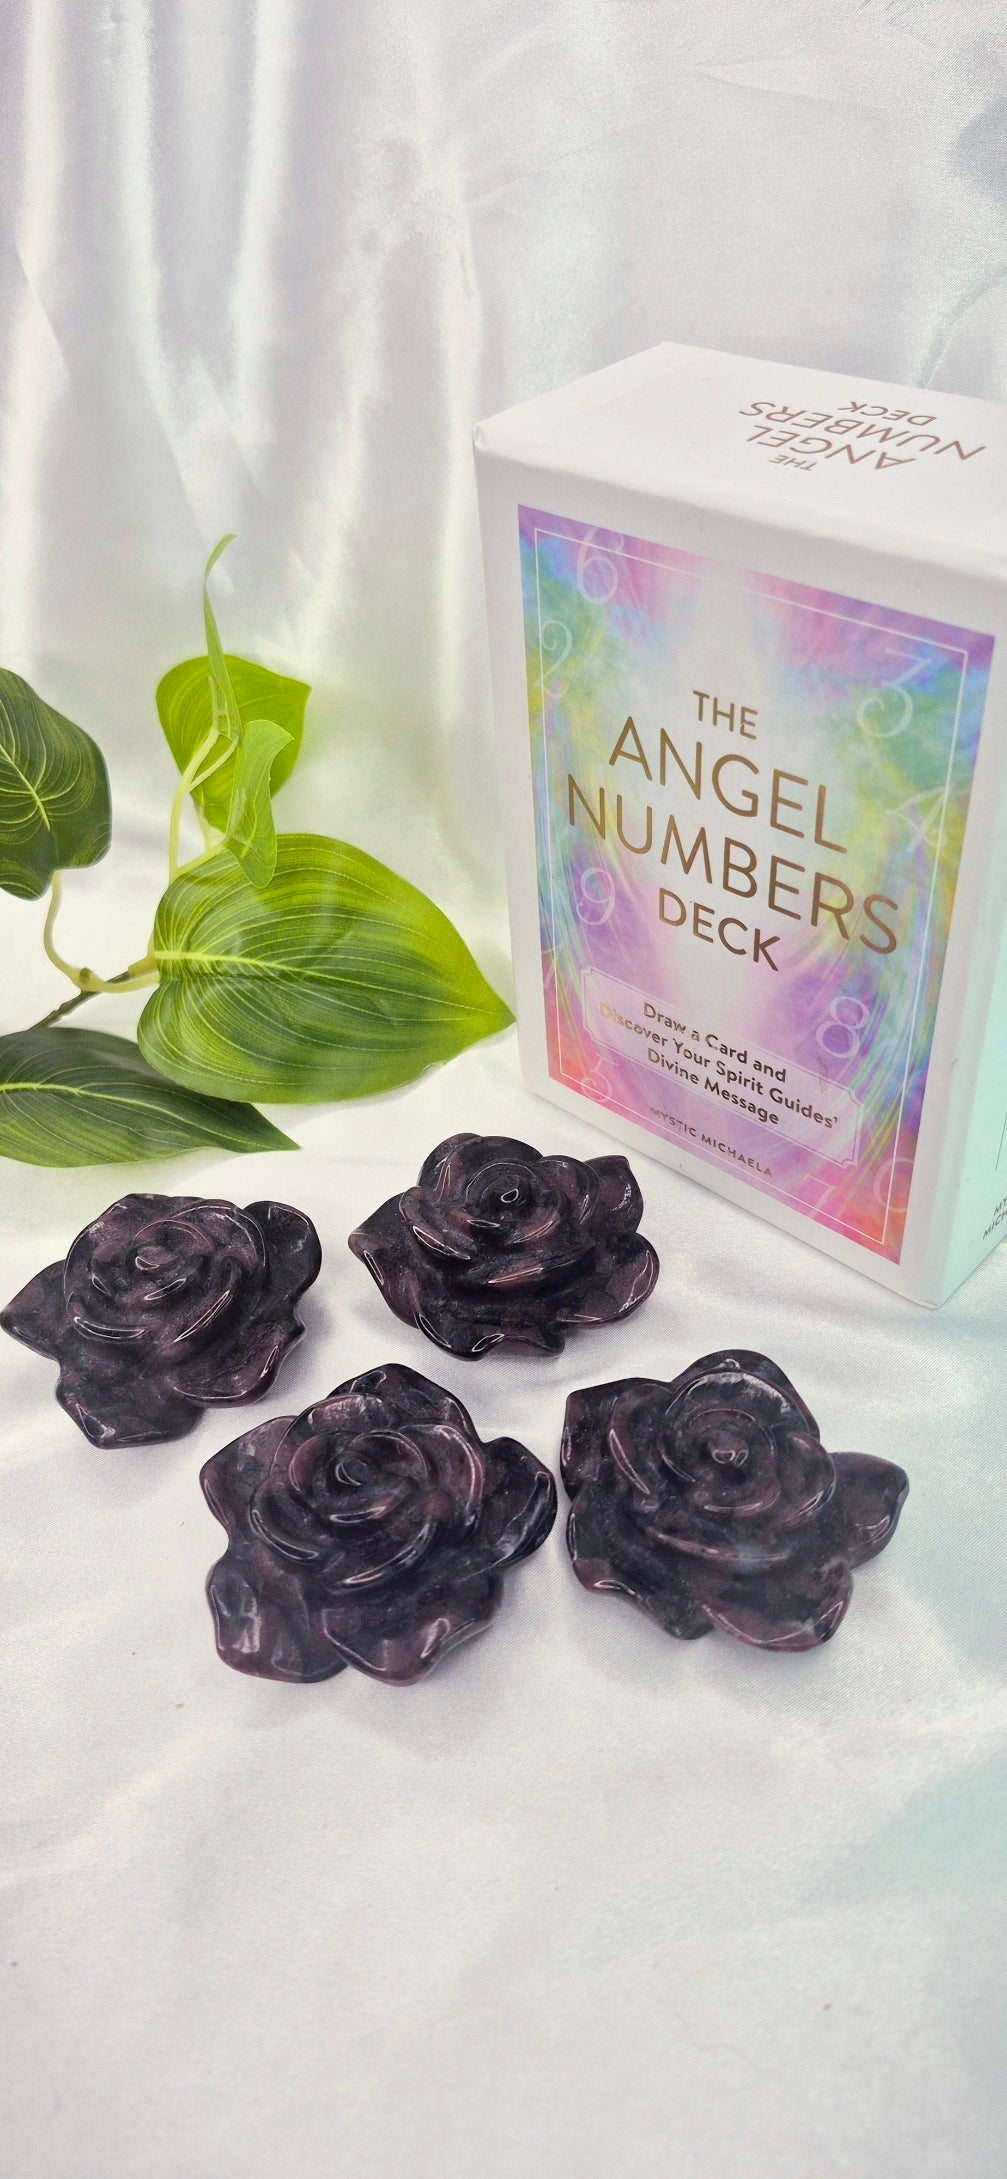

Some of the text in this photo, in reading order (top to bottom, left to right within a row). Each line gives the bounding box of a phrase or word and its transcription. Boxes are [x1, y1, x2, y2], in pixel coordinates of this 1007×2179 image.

[738, 402, 986, 461] NUMBERS
[746, 425, 917, 469] ANGEL
[837, 401, 938, 426] DECK
[768, 454, 818, 471] THE
[693, 690, 758, 740] THE
[609, 716, 847, 854] ANGEL
[568, 774, 899, 955] NUMBERS
[576, 867, 615, 926] 9
[658, 887, 781, 972] DECK
[600, 1002, 668, 1047] Discover
[672, 1038, 711, 1068] Your
[716, 1060, 764, 1096] Spirit
[643, 1002, 787, 1083] Draw a Card and
[816, 996, 870, 1058] 8
[648, 1048, 779, 1125] Divine Message
[650, 1106, 773, 1178] MYSTIC MICHAELA
